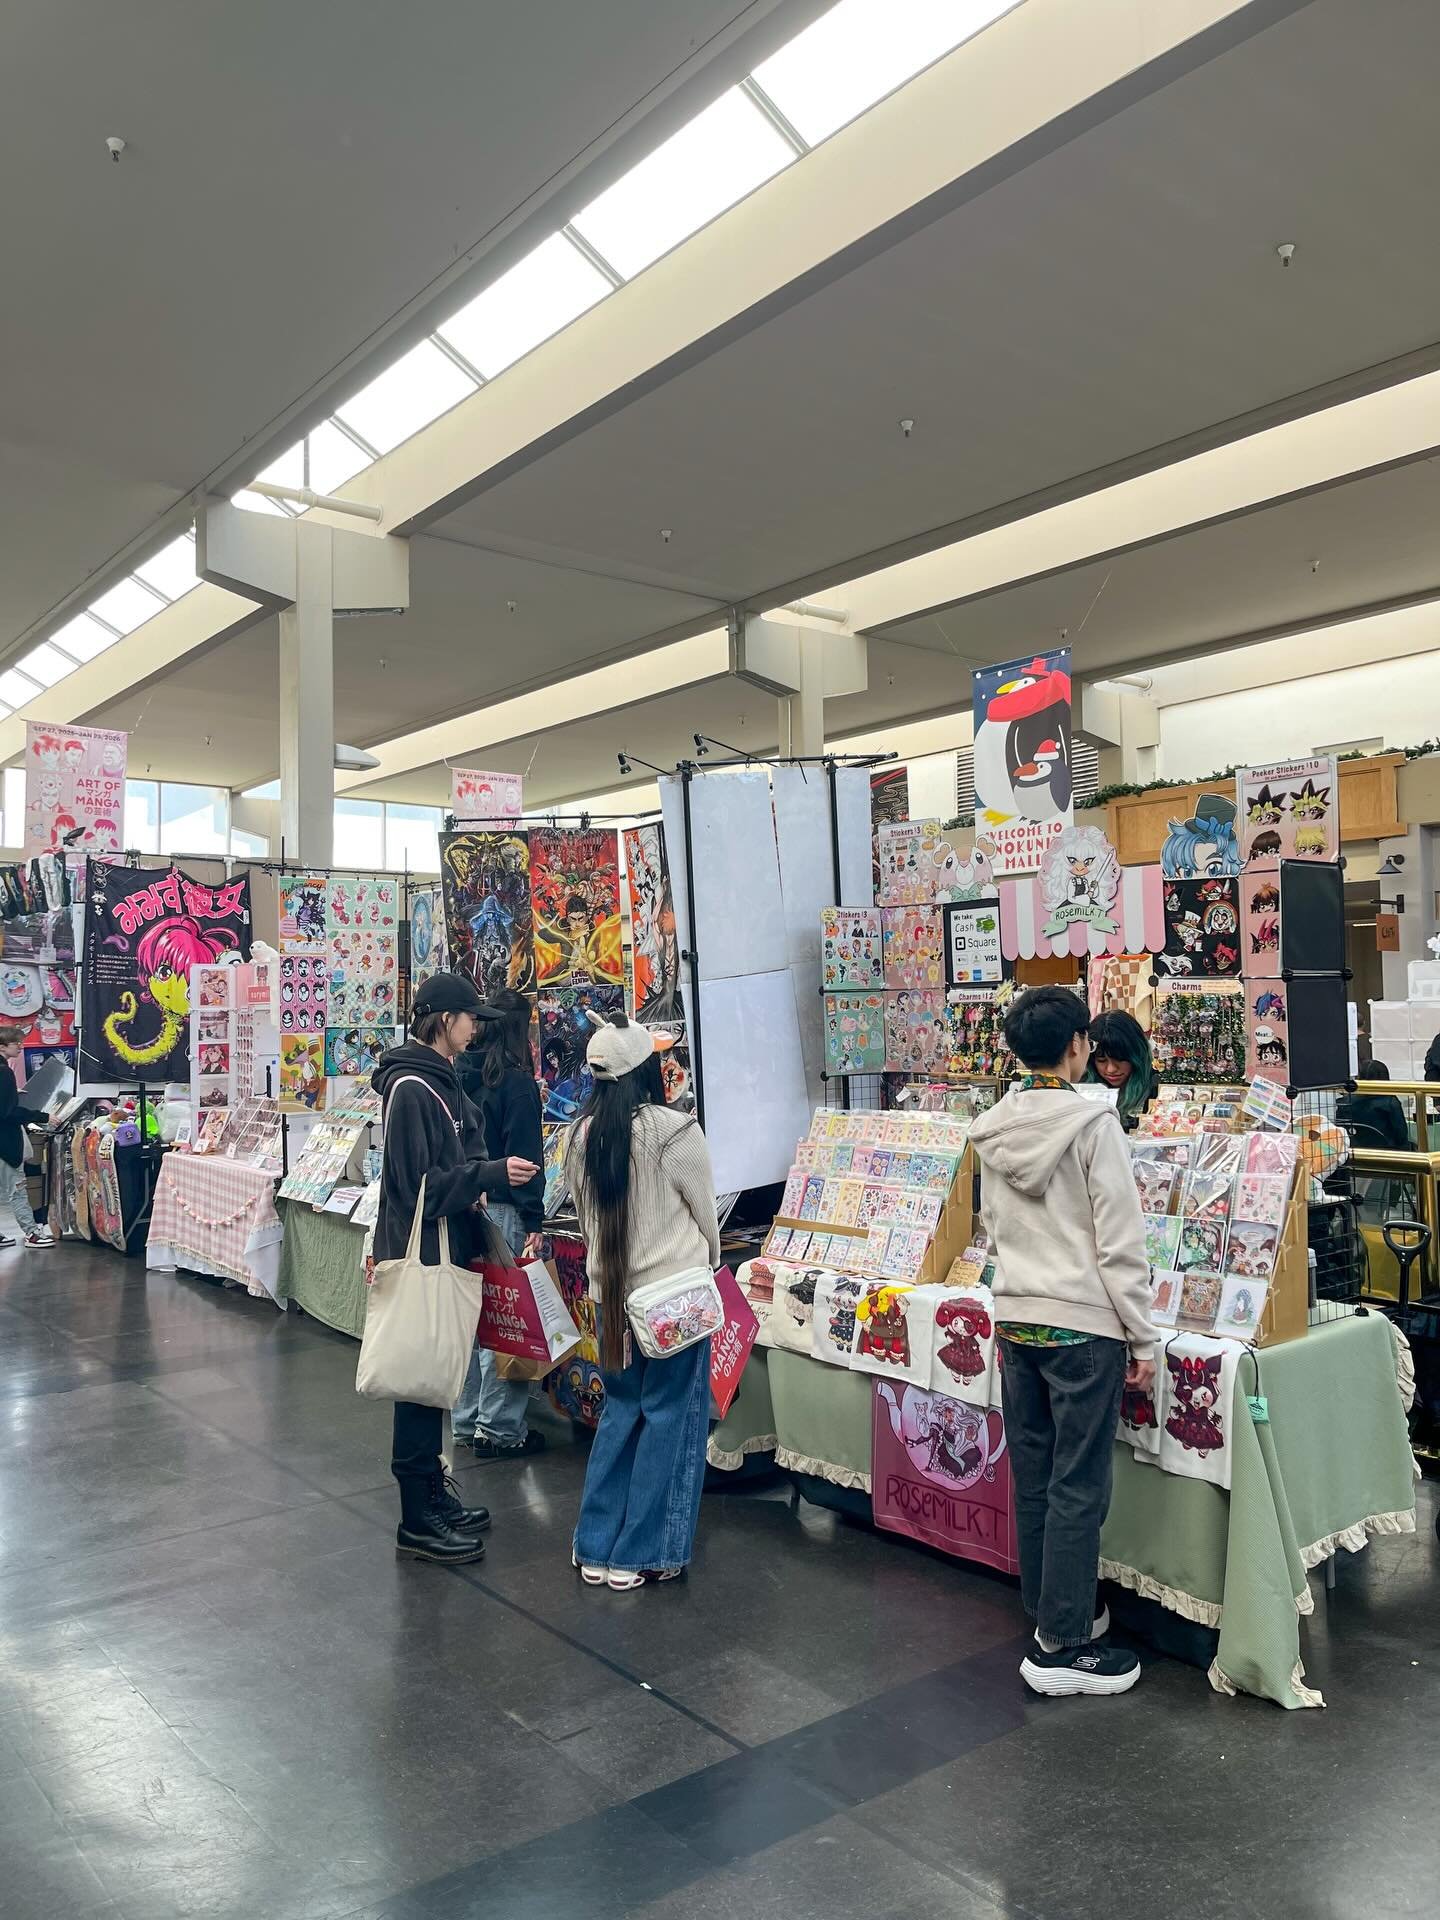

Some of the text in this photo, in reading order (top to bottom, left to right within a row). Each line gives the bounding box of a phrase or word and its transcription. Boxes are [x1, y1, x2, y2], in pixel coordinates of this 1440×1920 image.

[1276, 764, 1305, 774] Stickers
[77, 779, 121, 791] ART OF
[86, 789, 111, 799] マンガ
[75, 796, 121, 809] MANGA
[890, 829, 914, 837] Stickers
[1047, 822, 1063, 834] TO
[1005, 854, 1041, 869] MALL
[955, 923, 974, 933] Cash
[968, 938, 997, 949] Square
[1171, 982, 1202, 991] Charms
[483, 1283, 520, 1302] ART OF
[491, 1299, 515, 1314] マンガ
[486, 1311, 529, 1331] MANGA
[711, 1320, 741, 1380] MANGA
